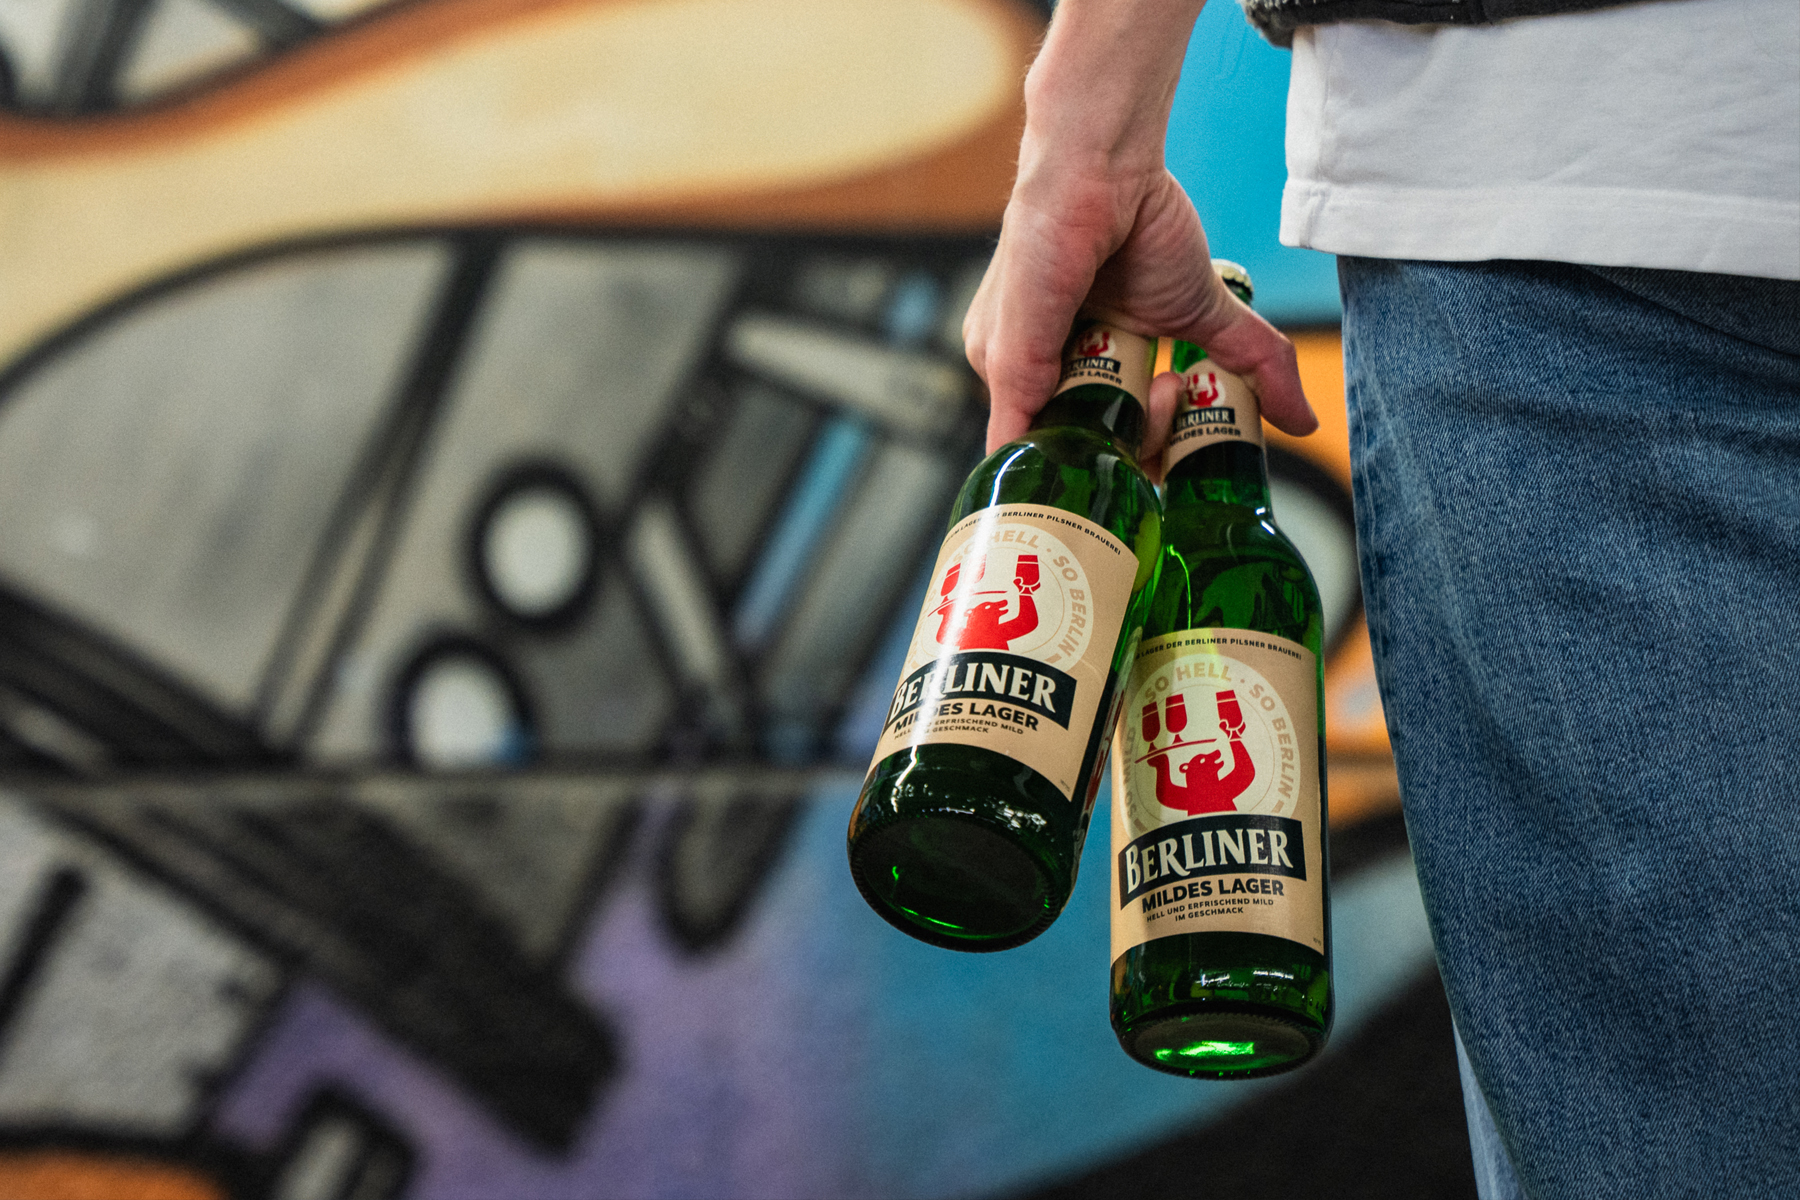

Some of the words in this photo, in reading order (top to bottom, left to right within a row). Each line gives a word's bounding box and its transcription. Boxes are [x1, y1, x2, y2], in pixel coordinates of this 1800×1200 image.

[1088, 371, 1122, 384] LAGER
[1206, 426, 1241, 437] LAGER
[1002, 511, 1044, 519] BERLINER
[1046, 515, 1082, 531] PILSNER
[1084, 528, 1121, 555] BRAUEREI
[1053, 555, 1078, 582] SO
[1058, 588, 1087, 657] BERLIN
[1141, 644, 1164, 657] LAGER
[1166, 641, 1182, 649] DER
[1185, 637, 1227, 647] BERLINER
[1230, 638, 1265, 648] PILSNER
[1268, 643, 1302, 660] BRAUEREI
[932, 725, 989, 734] GESCHMACK
[935, 718, 998, 728] ERFRISCHEND
[1001, 724, 1024, 734] MILD
[970, 703, 1038, 731] LAGER
[1145, 676, 1169, 700] SO
[1176, 662, 1232, 682] HELL
[1249, 683, 1276, 711] SO
[1271, 717, 1294, 799] BERLIN
[1125, 828, 1293, 895] BERLINER
[1142, 881, 1213, 914] MILDES
[1218, 878, 1284, 896] LAGER
[1147, 911, 1165, 923] HELL
[1167, 905, 1185, 915] UND
[1188, 898, 1250, 910] ERFRISCHEND
[1252, 898, 1274, 906] MILD
[1175, 914, 1186, 922] IM
[1188, 907, 1244, 919] GESCHMACK
